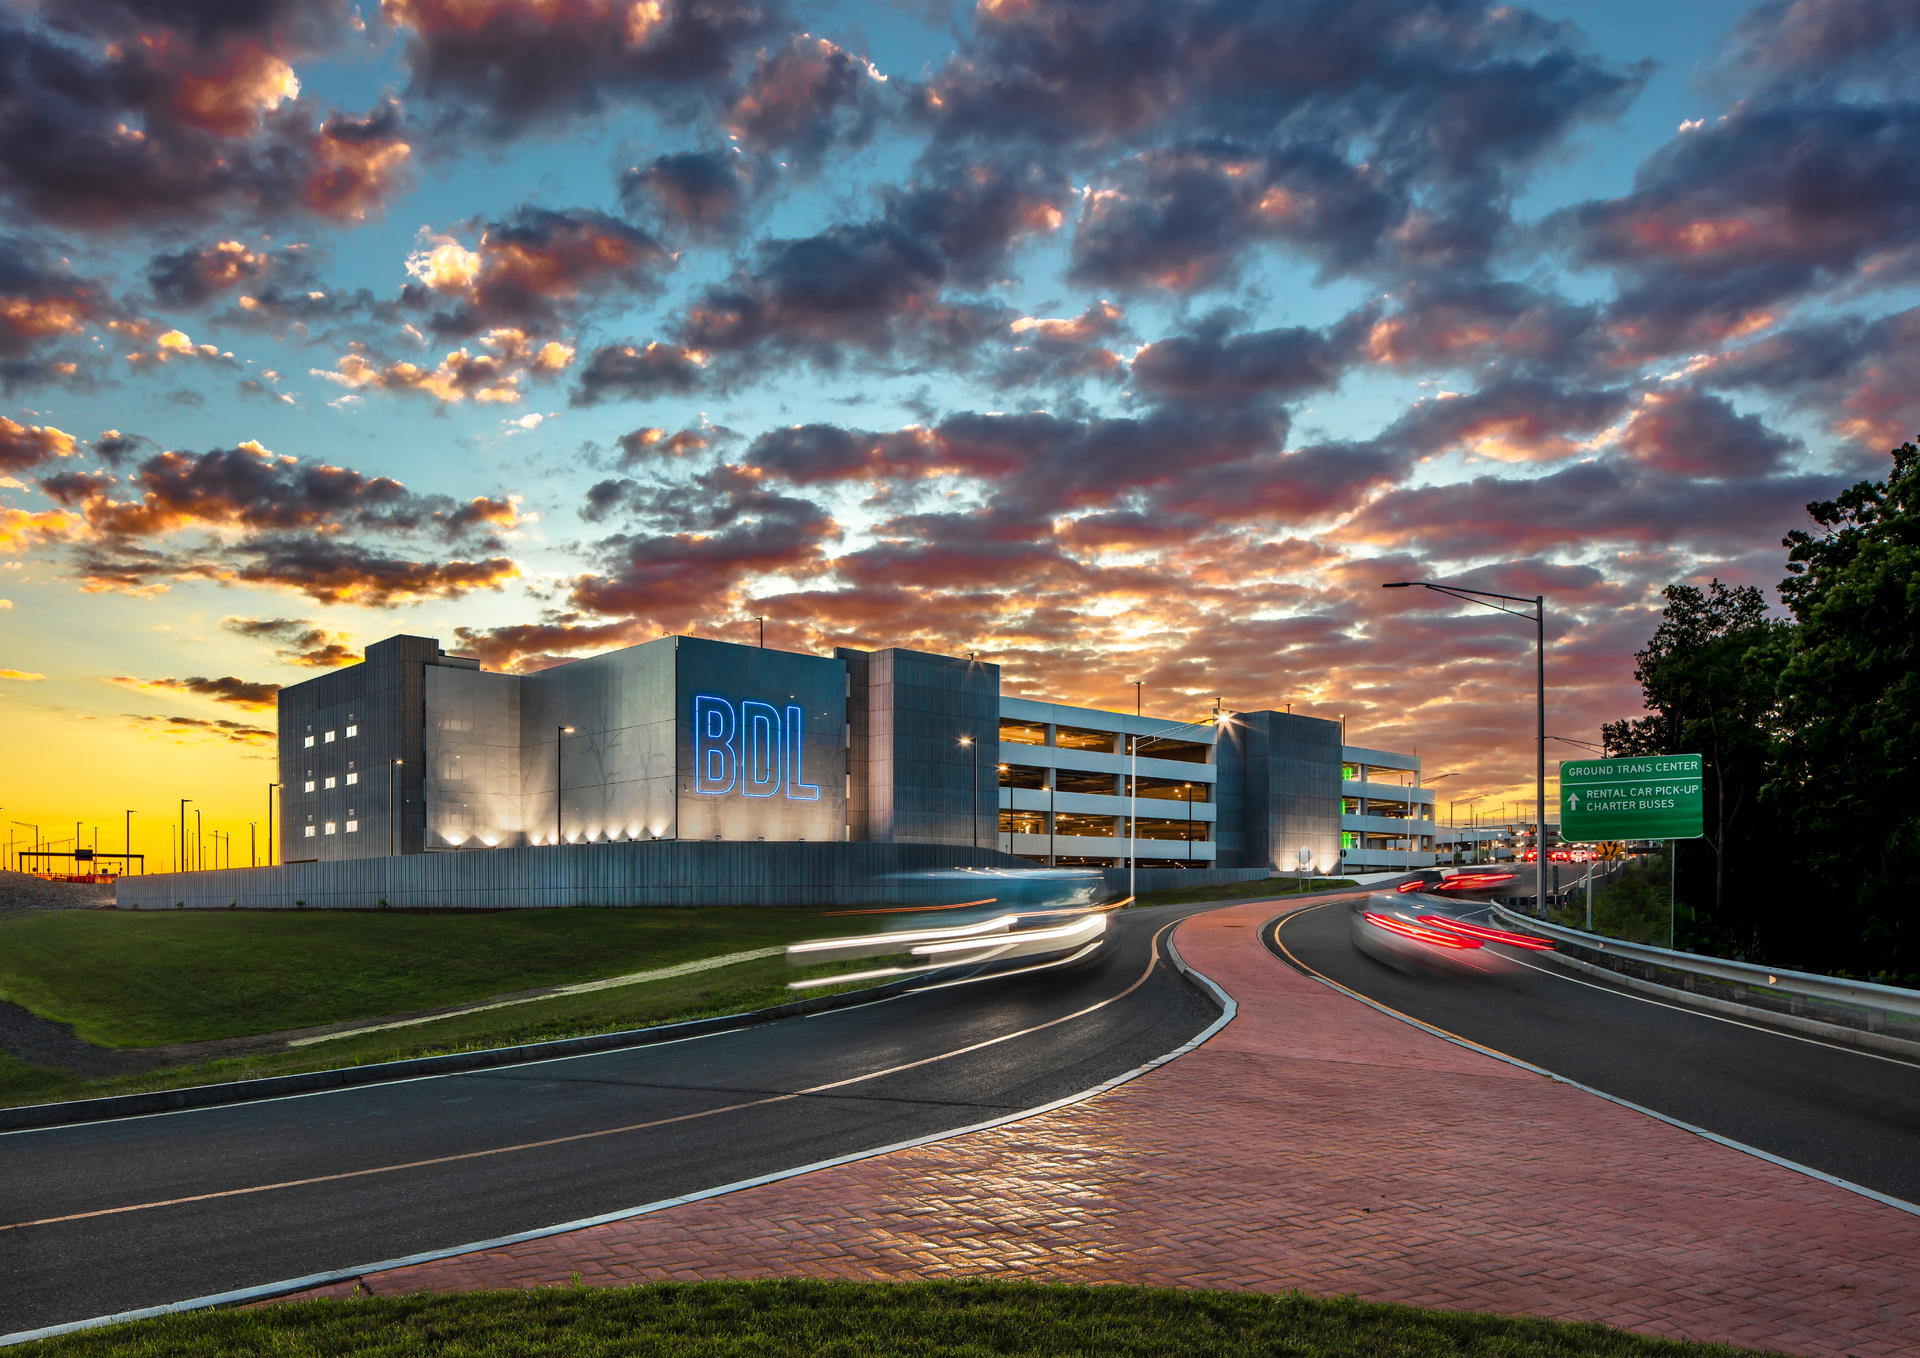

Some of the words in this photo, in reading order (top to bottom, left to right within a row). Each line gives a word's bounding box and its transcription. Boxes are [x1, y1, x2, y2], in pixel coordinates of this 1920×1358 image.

[695, 695, 820, 801] BDL
[1569, 766, 1613, 776] GROUND
[1617, 764, 1652, 774] TRANS
[1655, 761, 1698, 772] CENTER
[1586, 789, 1627, 799] RENTAL
[1629, 787, 1653, 797] CAR
[1655, 785, 1699, 796] PICK-UP
[1586, 801, 1636, 812] CHARTER
[1639, 799, 1675, 810] BUSES
